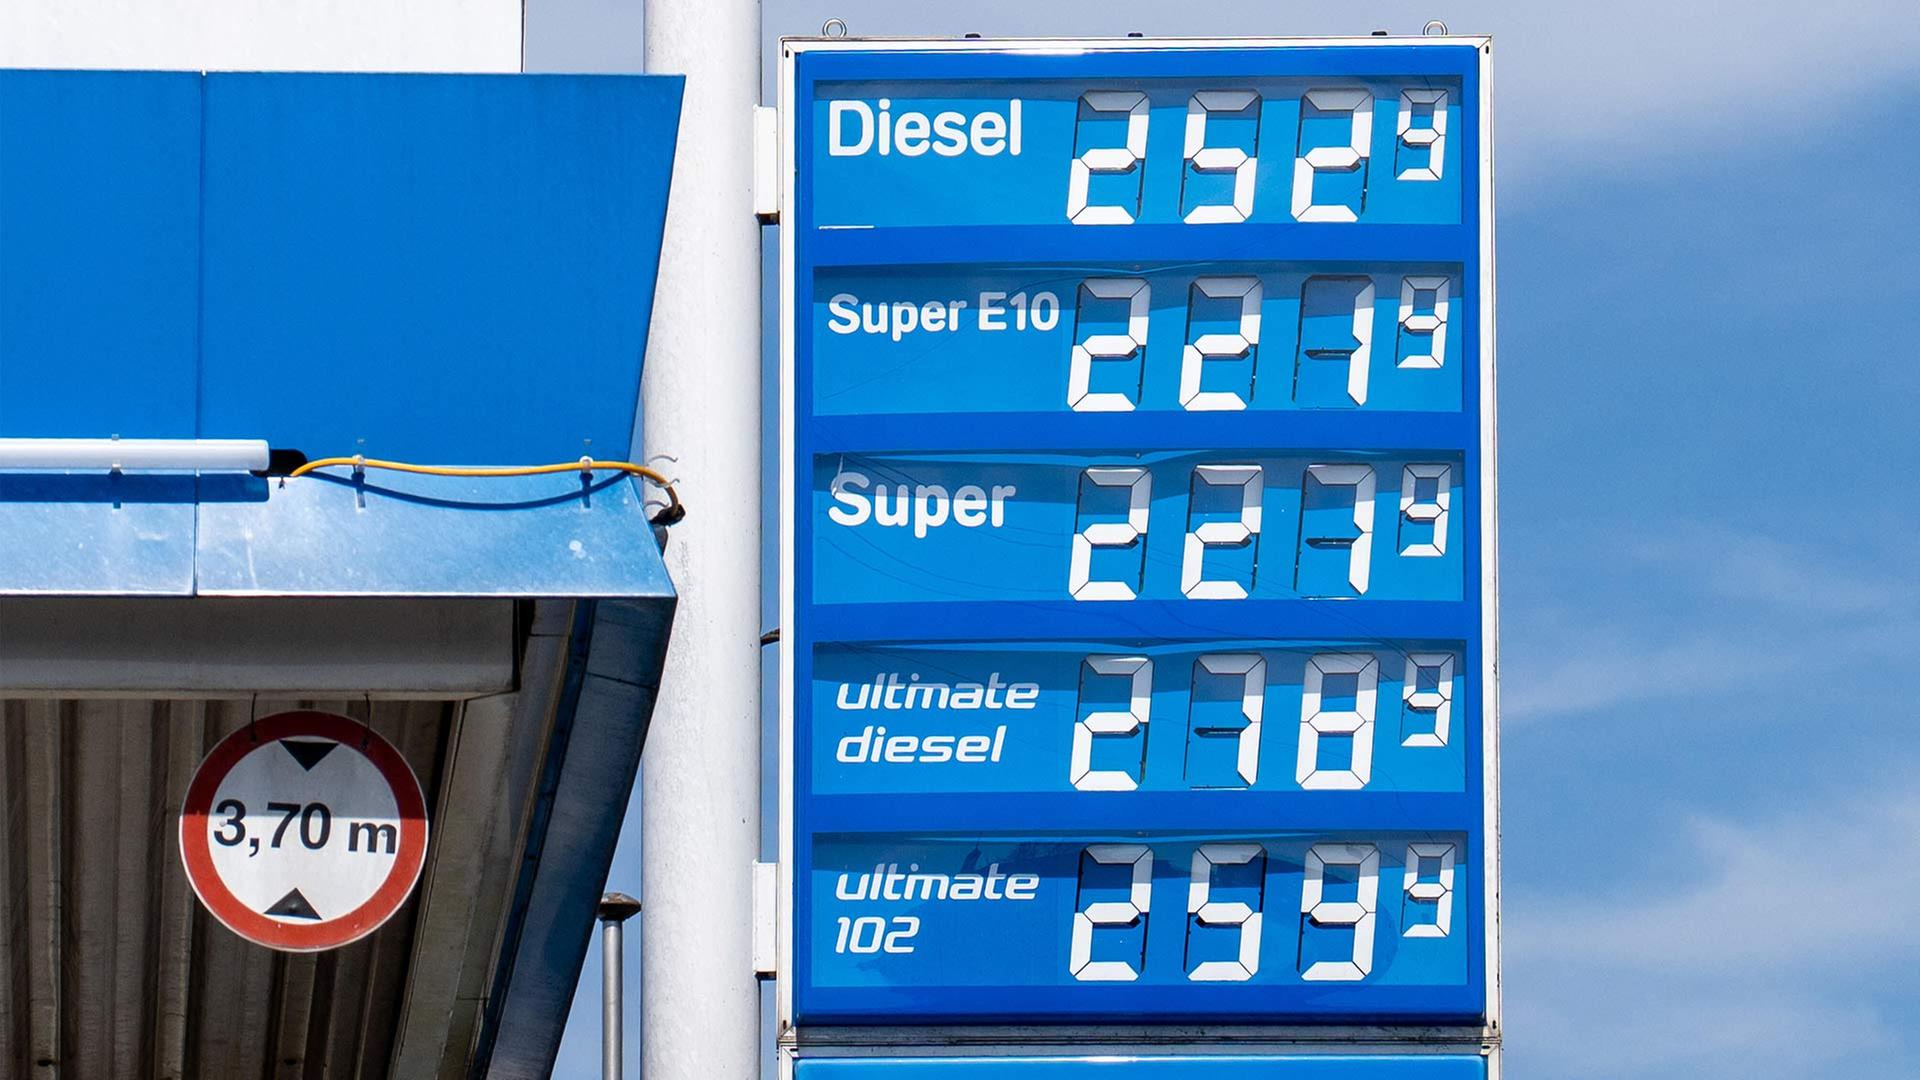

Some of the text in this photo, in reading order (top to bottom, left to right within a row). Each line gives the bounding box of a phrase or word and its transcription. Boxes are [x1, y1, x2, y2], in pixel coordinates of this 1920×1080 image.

[828, 99, 1022, 158] Diesel
[828, 291, 1060, 342] Super E10
[828, 470, 1017, 539] Super
[836, 672, 1040, 712] ultimate
[836, 724, 1006, 765] diesel
[213, 798, 397, 858] 3,70 m
[835, 863, 1040, 902] ultimate
[835, 916, 920, 954] 102
